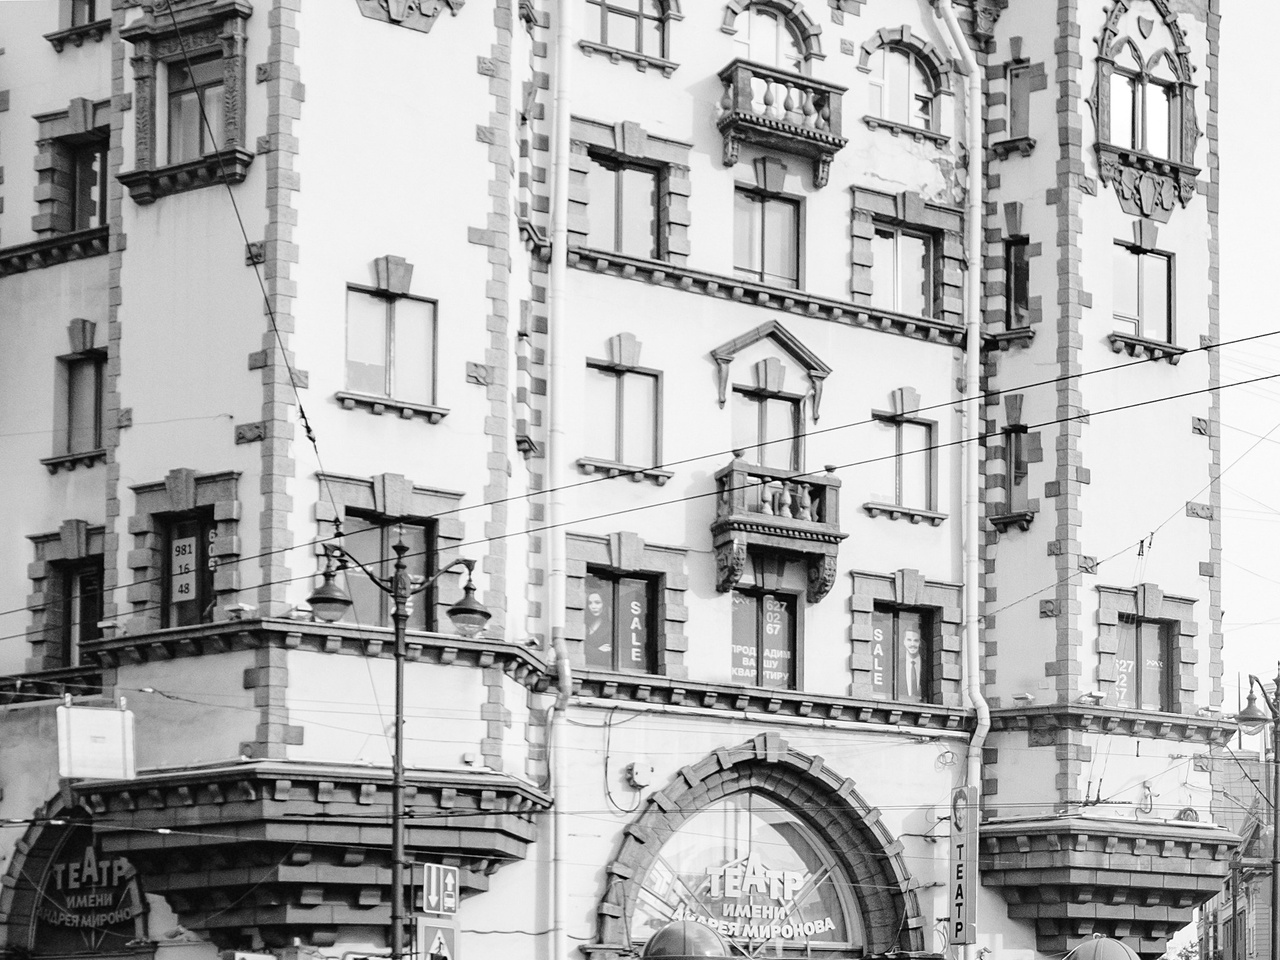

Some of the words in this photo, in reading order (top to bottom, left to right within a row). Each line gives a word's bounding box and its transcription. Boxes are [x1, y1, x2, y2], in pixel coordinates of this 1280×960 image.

[175, 544, 192, 557] 981
[179, 564, 190, 574] 16
[178, 583, 190, 594] 48
[766, 600, 787, 612] 627
[766, 612, 781, 623] 02
[630, 601, 642, 661] SALE
[766, 624, 781, 635] 67
[873, 628, 884, 685] SALE
[53, 846, 126, 890] ТЕАТР
[706, 851, 804, 900] ТЕАТР
[955, 843, 964, 938] ТЕАТР
[66, 894, 114, 908] ИМЕНИ
[81, 908, 132, 927] МИРОНО
[722, 903, 787, 919] ИМЕНИ
[743, 917, 836, 939] МИРОНОВА
